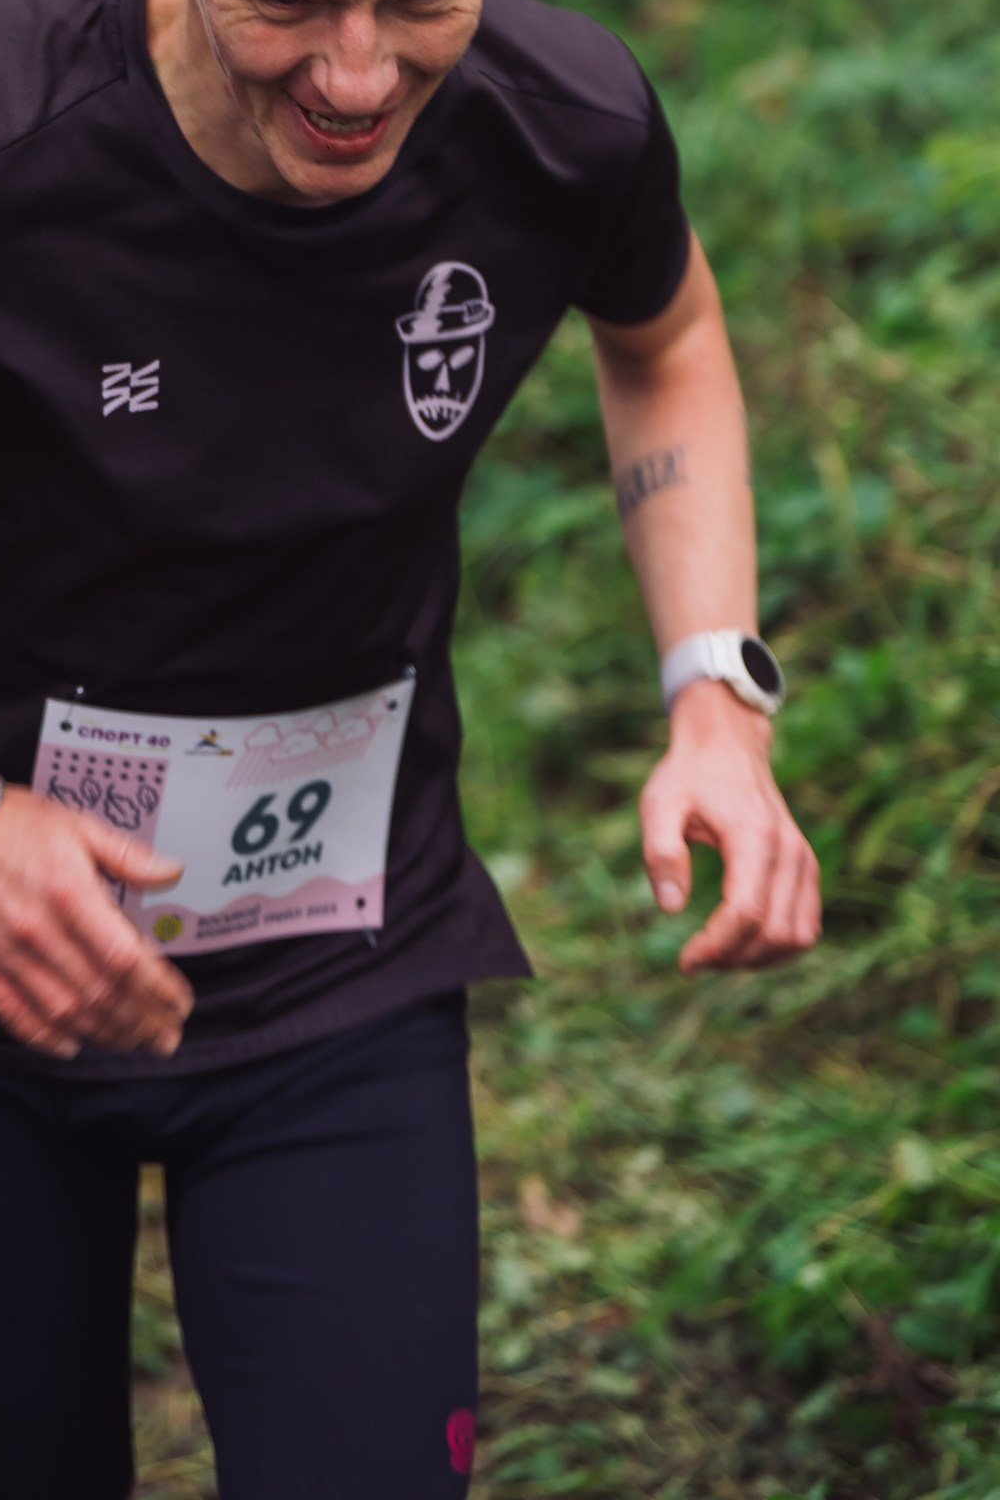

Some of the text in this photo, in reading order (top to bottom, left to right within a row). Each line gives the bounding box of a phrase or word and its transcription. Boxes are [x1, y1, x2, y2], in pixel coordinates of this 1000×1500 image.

[78, 725, 143, 746] СПОРТ
[147, 735, 171, 748] 40
[231, 779, 332, 856] 69
[222, 841, 323, 887] АНТОН
